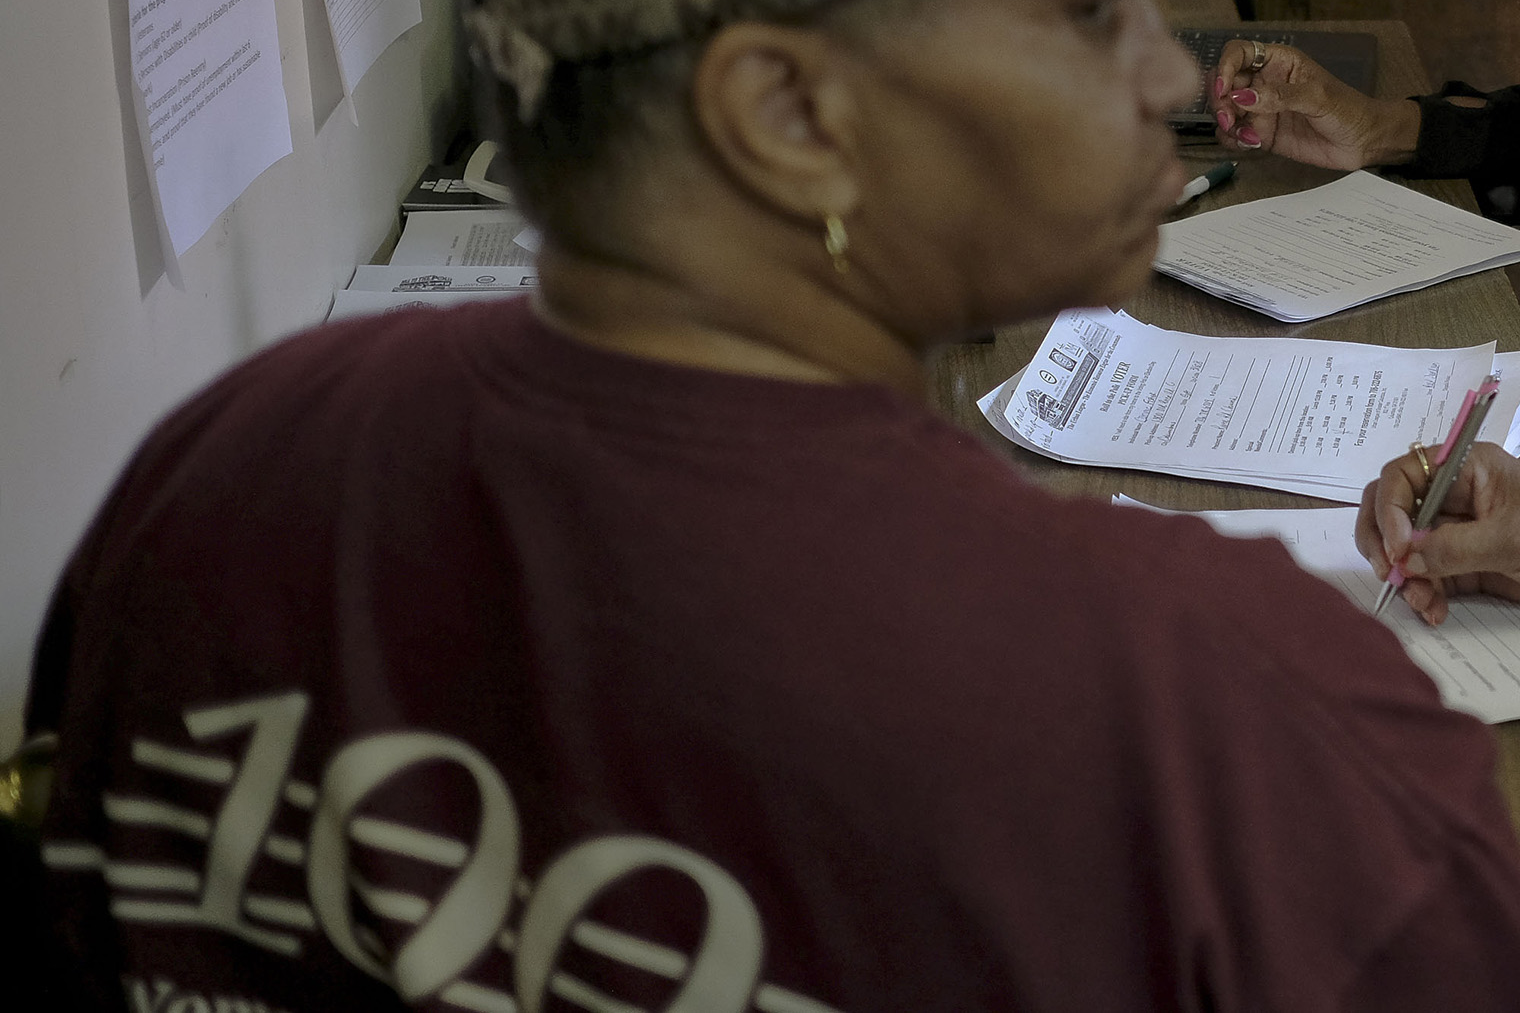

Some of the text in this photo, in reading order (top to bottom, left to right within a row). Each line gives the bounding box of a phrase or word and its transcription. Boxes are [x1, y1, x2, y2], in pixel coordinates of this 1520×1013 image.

[1110, 362, 1130, 383] VOTER
[1118, 375, 1138, 405] PICK-UP FORM
[1359, 429, 1367, 438] your
[111, 690, 765, 1013] 100
